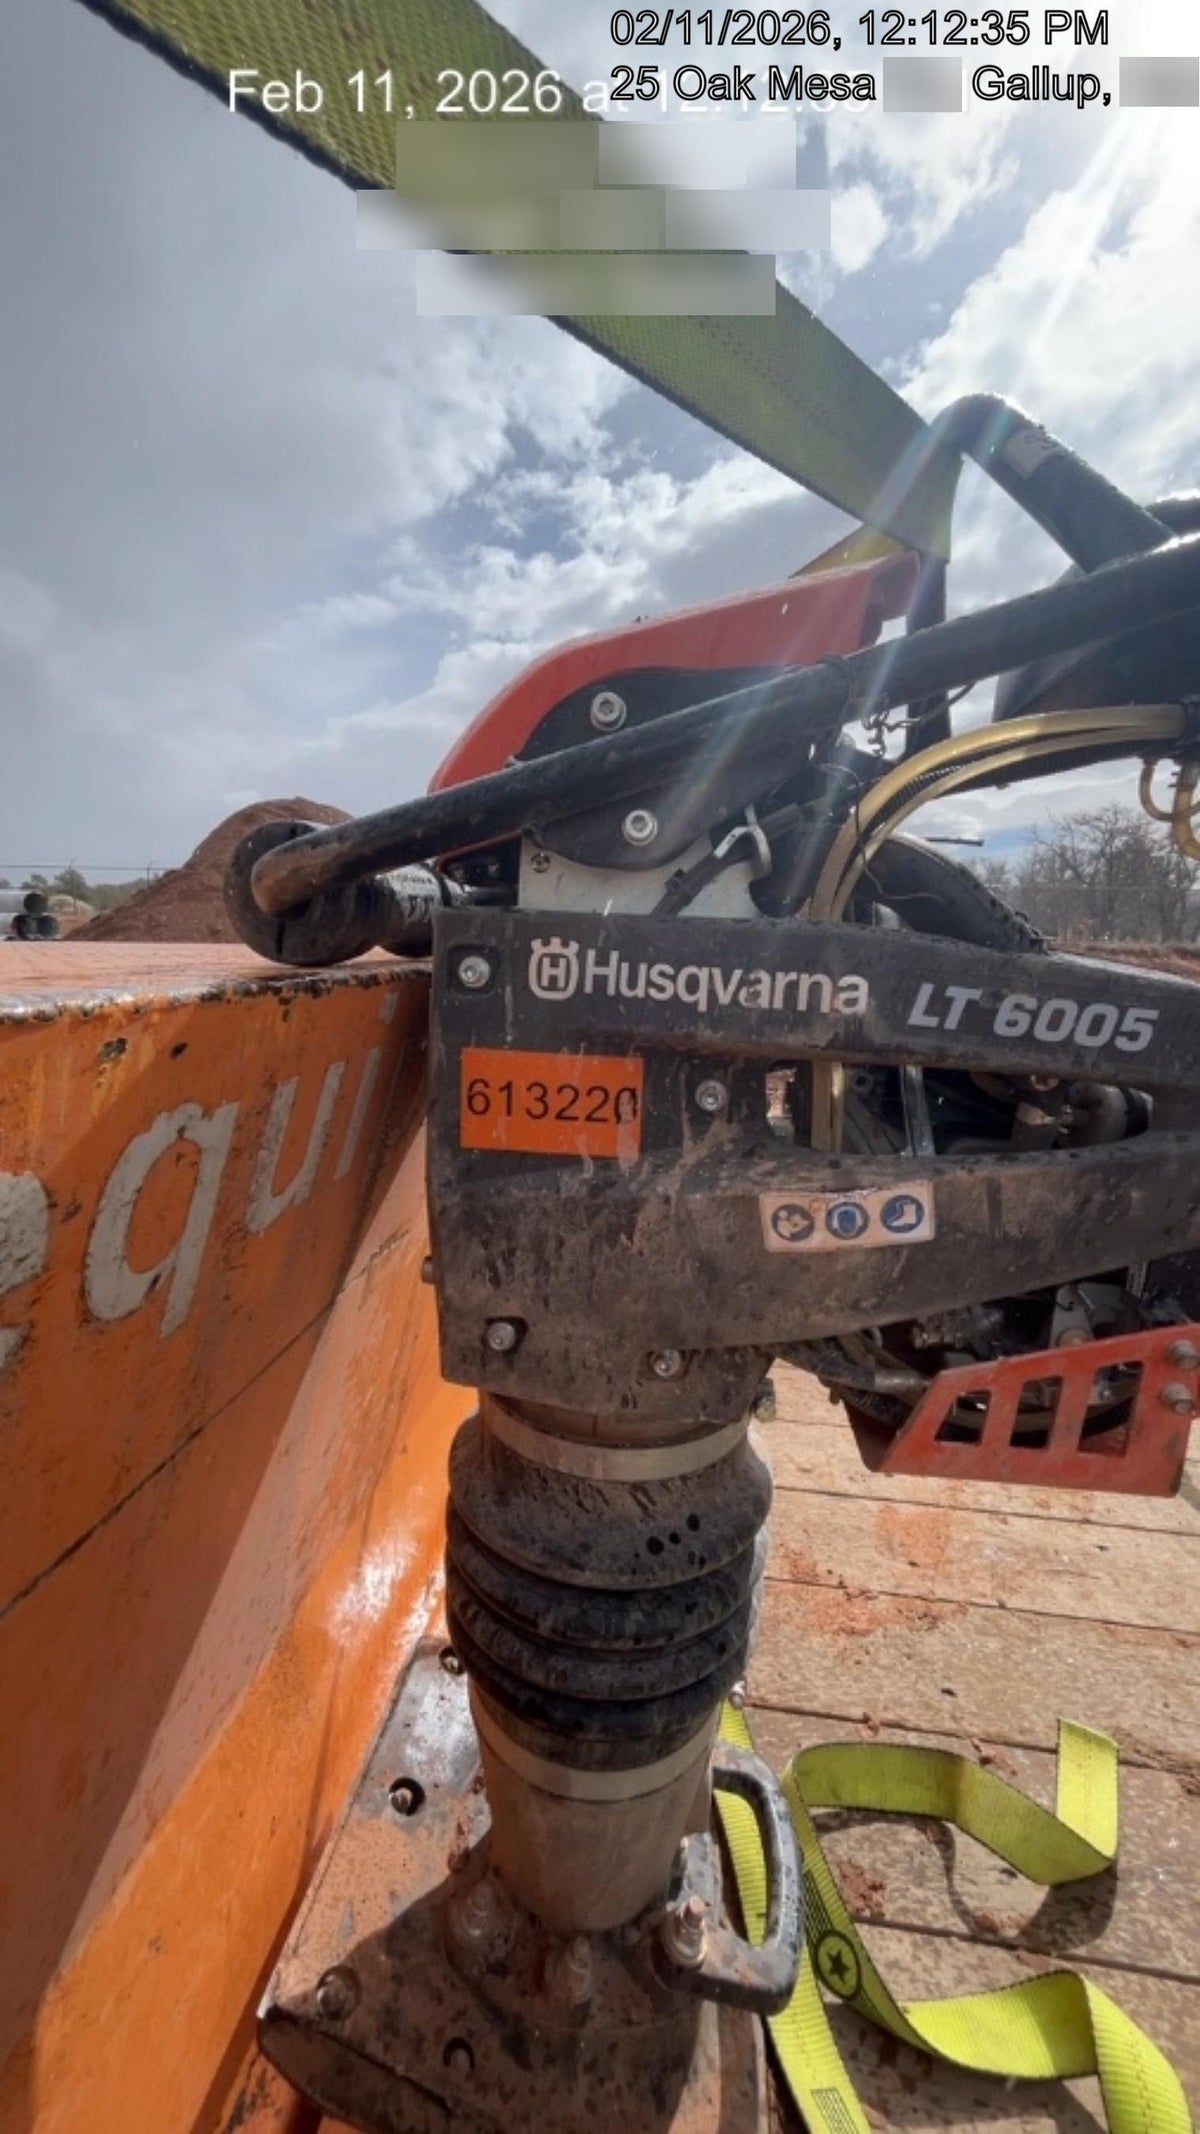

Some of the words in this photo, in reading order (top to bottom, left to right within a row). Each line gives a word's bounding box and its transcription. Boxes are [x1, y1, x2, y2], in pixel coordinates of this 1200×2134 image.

[584, 948, 869, 1015] Husqvarna
[907, 983, 983, 1030] LT
[993, 993, 1159, 1052] 6005
